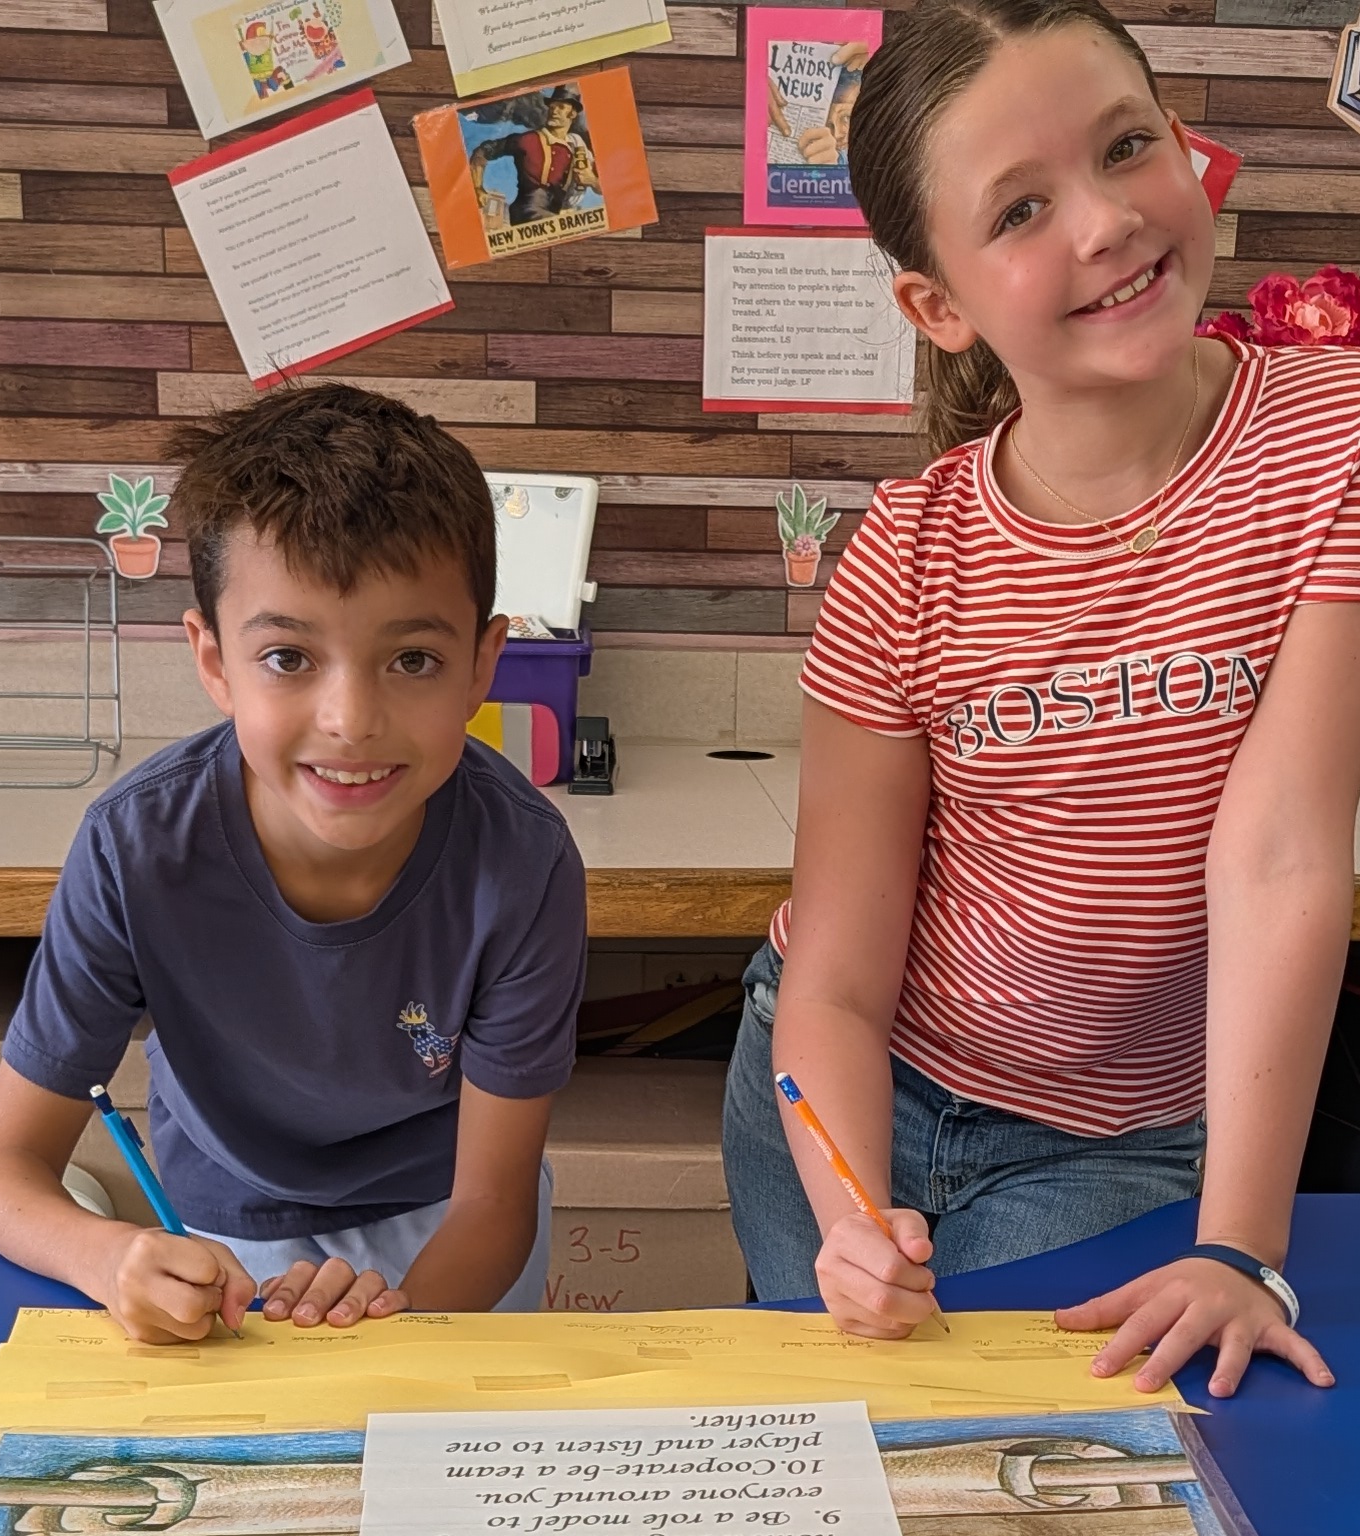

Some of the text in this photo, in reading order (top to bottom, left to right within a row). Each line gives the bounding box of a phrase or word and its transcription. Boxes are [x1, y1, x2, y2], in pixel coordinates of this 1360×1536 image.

[769, 45, 838, 80] LANDRY
[791, 42, 815, 56] THE
[777, 75, 824, 102] NEWS
[487, 208, 605, 248] NEW YORK'S BRAVEST
[733, 250, 763, 260] Landry
[749, 282, 785, 290] attention
[945, 651, 1270, 759] BOSTON
[569, 1226, 641, 1263] 3-5
[546, 1274, 624, 1310] View
[690, 1412, 816, 1432] another.
[445, 1431, 822, 1457] player and listen to one
[475, 1482, 823, 1509] everyone around you.
[487, 1509, 841, 1533] 9. Be a role model to
